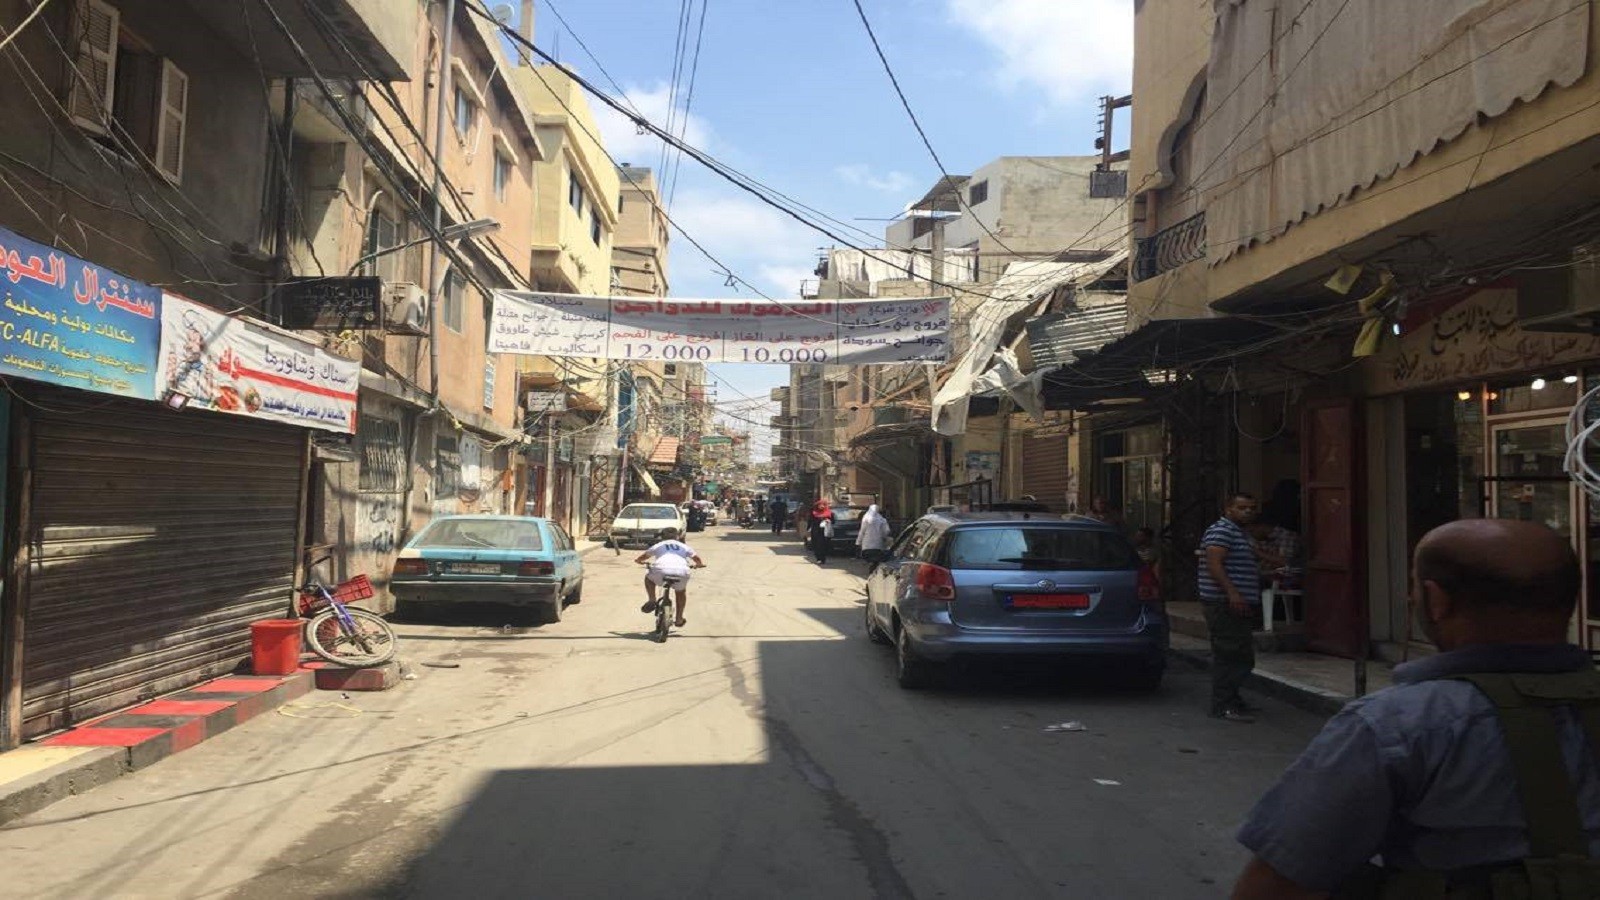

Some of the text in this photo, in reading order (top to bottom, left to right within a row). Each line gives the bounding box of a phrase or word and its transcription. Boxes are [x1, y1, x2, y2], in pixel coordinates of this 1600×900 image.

[0, 244, 155, 319] سنترال العو
[4, 292, 57, 325] ومحلية
[61, 309, 91, 333] دولية
[913, 316, 946, 331] فروج
[612, 328, 650, 340] الفحم
[686, 331, 720, 344] فروج
[800, 331, 835, 345] فروج
[623, 343, 711, 360] 12.000
[742, 347, 827, 362] 10.000
[319, 363, 347, 384] سناك
